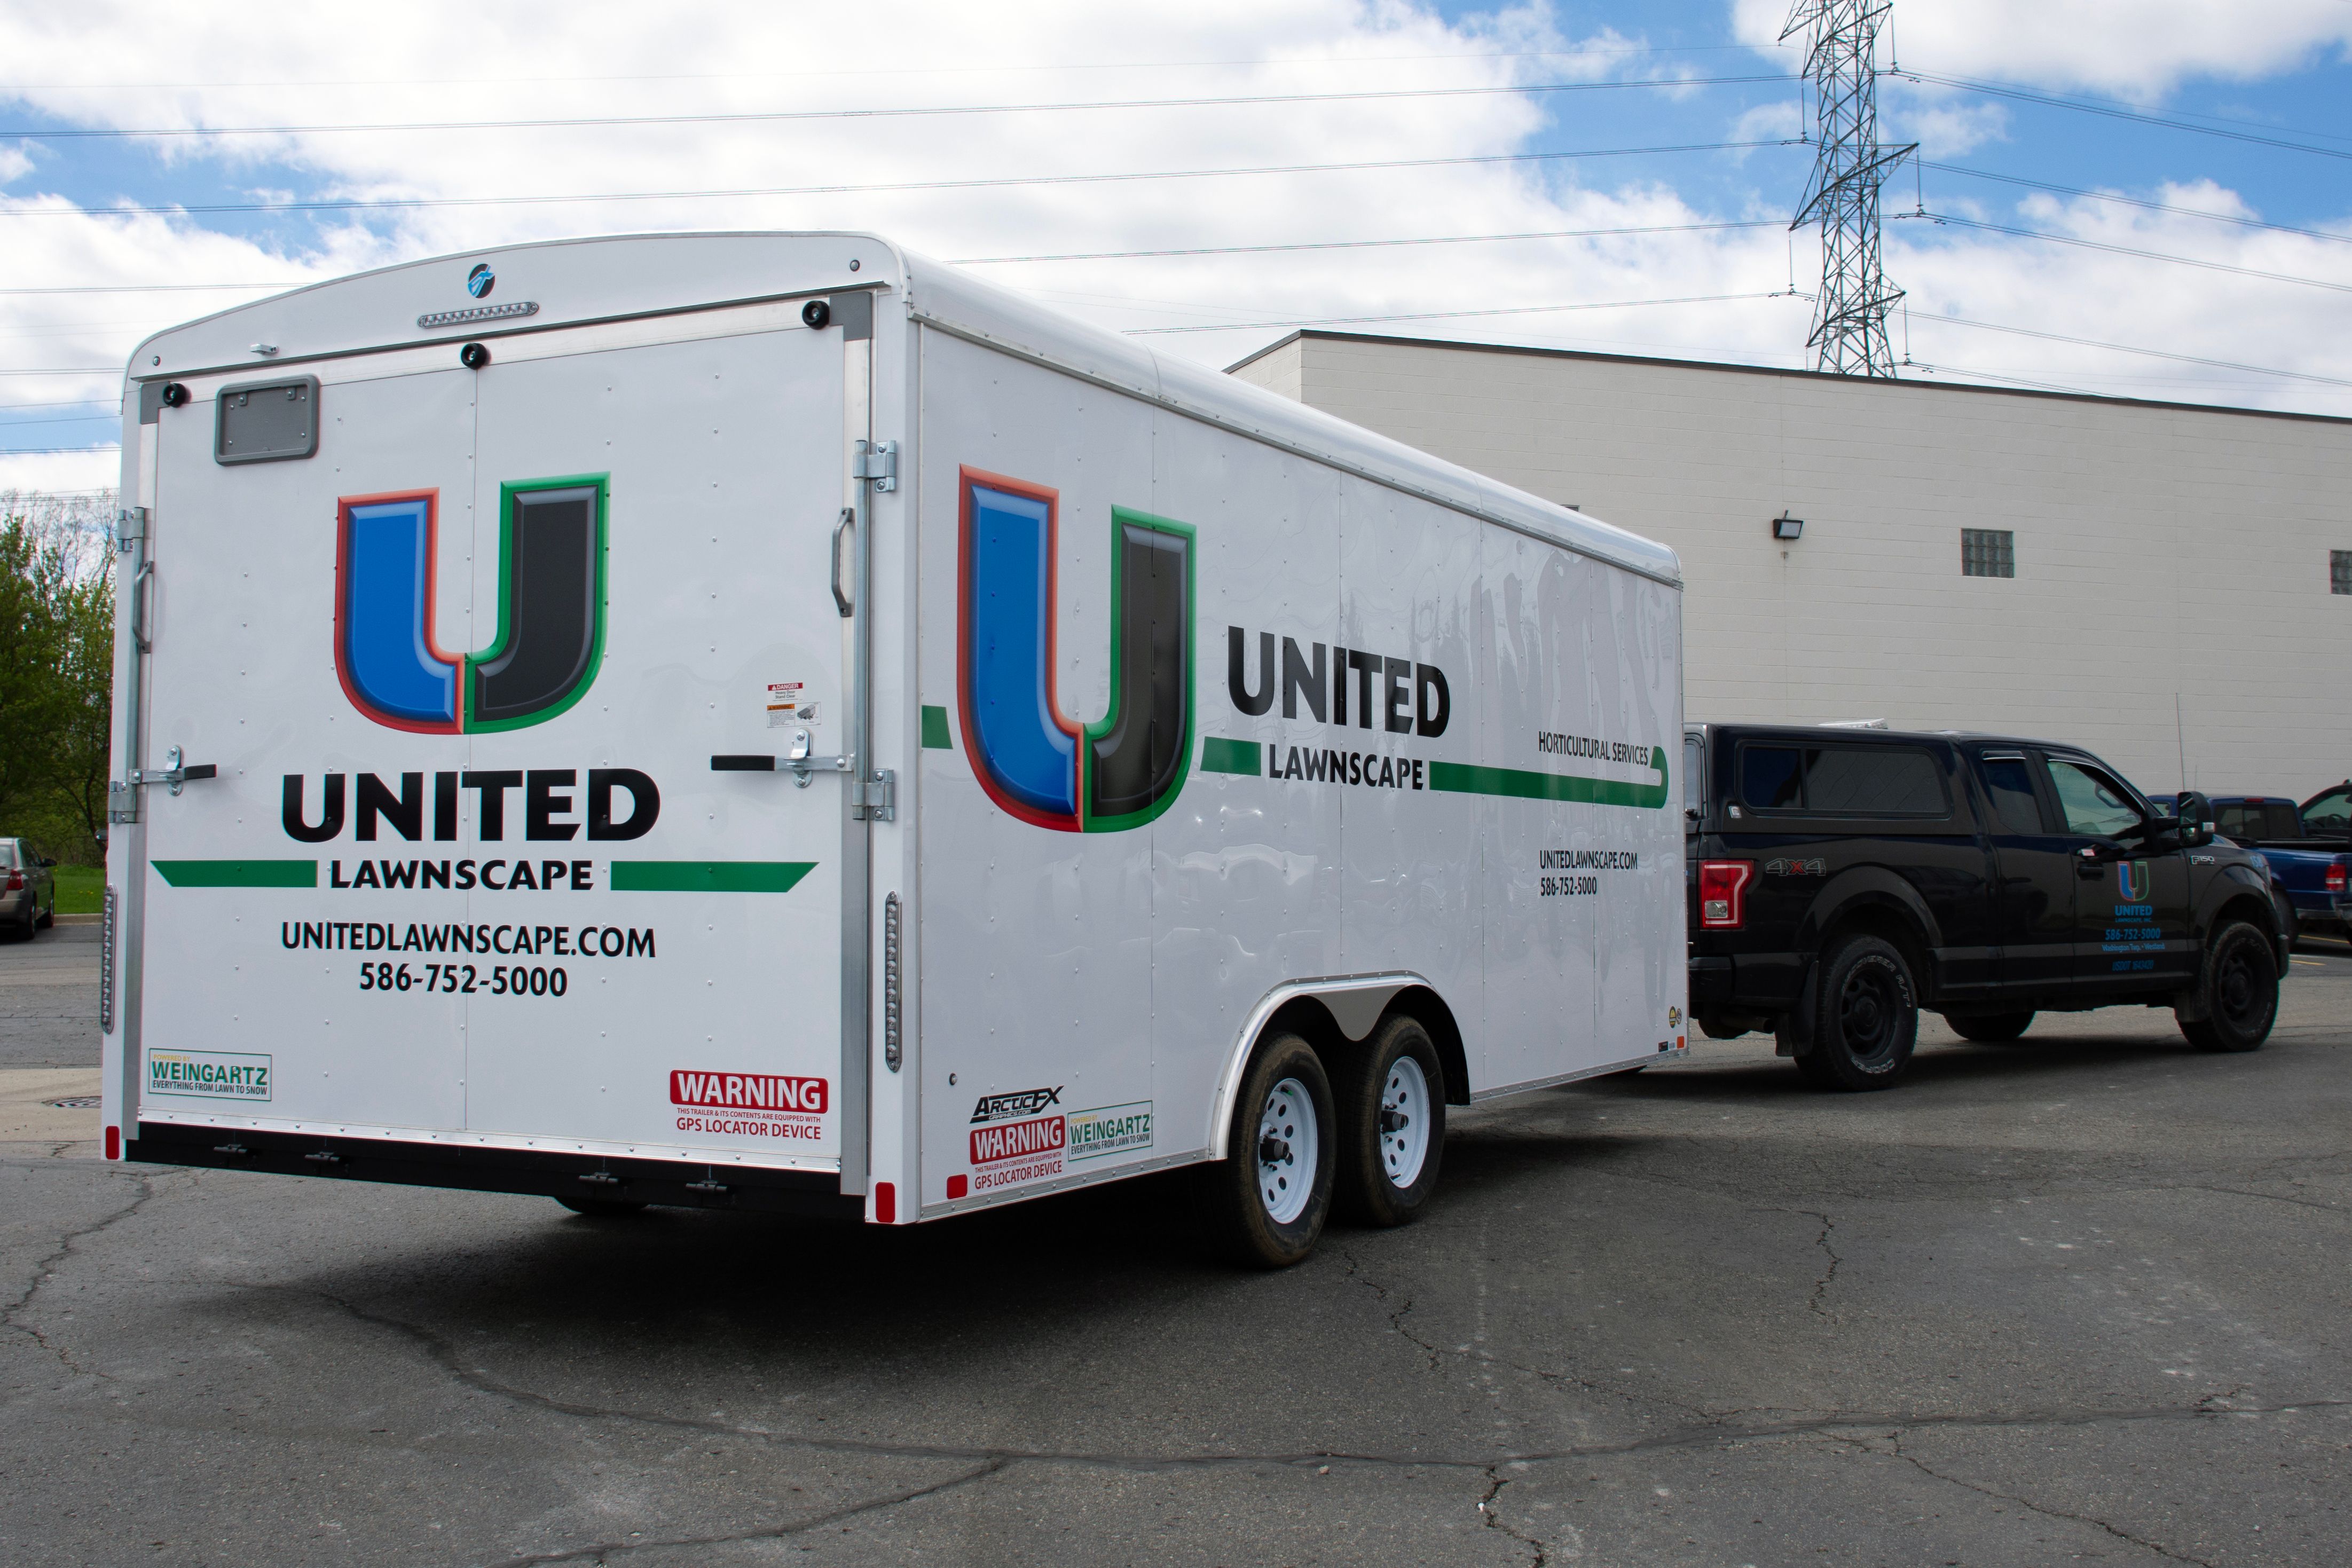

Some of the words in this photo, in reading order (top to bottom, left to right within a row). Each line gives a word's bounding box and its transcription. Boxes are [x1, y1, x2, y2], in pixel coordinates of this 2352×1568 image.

[1228, 626, 1450, 738] UNITED
[1539, 731, 1610, 760] HORTICULTURAL
[1612, 742, 1648, 766] SERVICES
[1269, 744, 1423, 790] LAWNSCAPE
[282, 768, 660, 843] UNITED
[1540, 850, 1638, 869] UNITEDLAWNSCAPE.COM
[331, 860, 595, 891] LAWNSCAPE
[1540, 877, 1597, 896] 586-752-5000
[2114, 905, 2153, 916] UNITED
[282, 921, 656, 958] UNITEDLAWNSCAPE.COM
[2105, 928, 2161, 940] 586-752-5000
[2102, 944, 2129, 952] Washington
[359, 962, 568, 997] 586-752-5000
[152, 1061, 268, 1085] WEINGARTZ
[153, 1080, 193, 1090] EVERYTHING
[195, 1082, 214, 1092] FROM
[215, 1084, 234, 1093] LAWN
[236, 1085, 245, 1093] TO
[246, 1086, 267, 1094] SNOW
[678, 1073, 820, 1109] WARNING
[677, 1117, 702, 1131] GPS
[706, 1119, 768, 1136] LOCATOR
[772, 1123, 821, 1139] DEVICE
[730, 1111, 761, 1119] CONTENTS
[775, 1114, 804, 1122] EQUIPPED
[1071, 1115, 1091, 1124] POWERED
[975, 1119, 1061, 1160] WARNING
[1070, 1114, 1150, 1144] WEINGARTZ
[1071, 1141, 1100, 1155] EVERYTHING
[1102, 1139, 1115, 1148] FROM
[1116, 1137, 1129, 1146] LAWN
[1136, 1133, 1150, 1142] SNOW
[1009, 1158, 1028, 1168] CONTENTS
[1035, 1153, 1052, 1162] EQUIPPED
[975, 1174, 992, 1189] GPS
[994, 1167, 1032, 1186] LOCATOR
[1034, 1160, 1061, 1178] DEVICE
